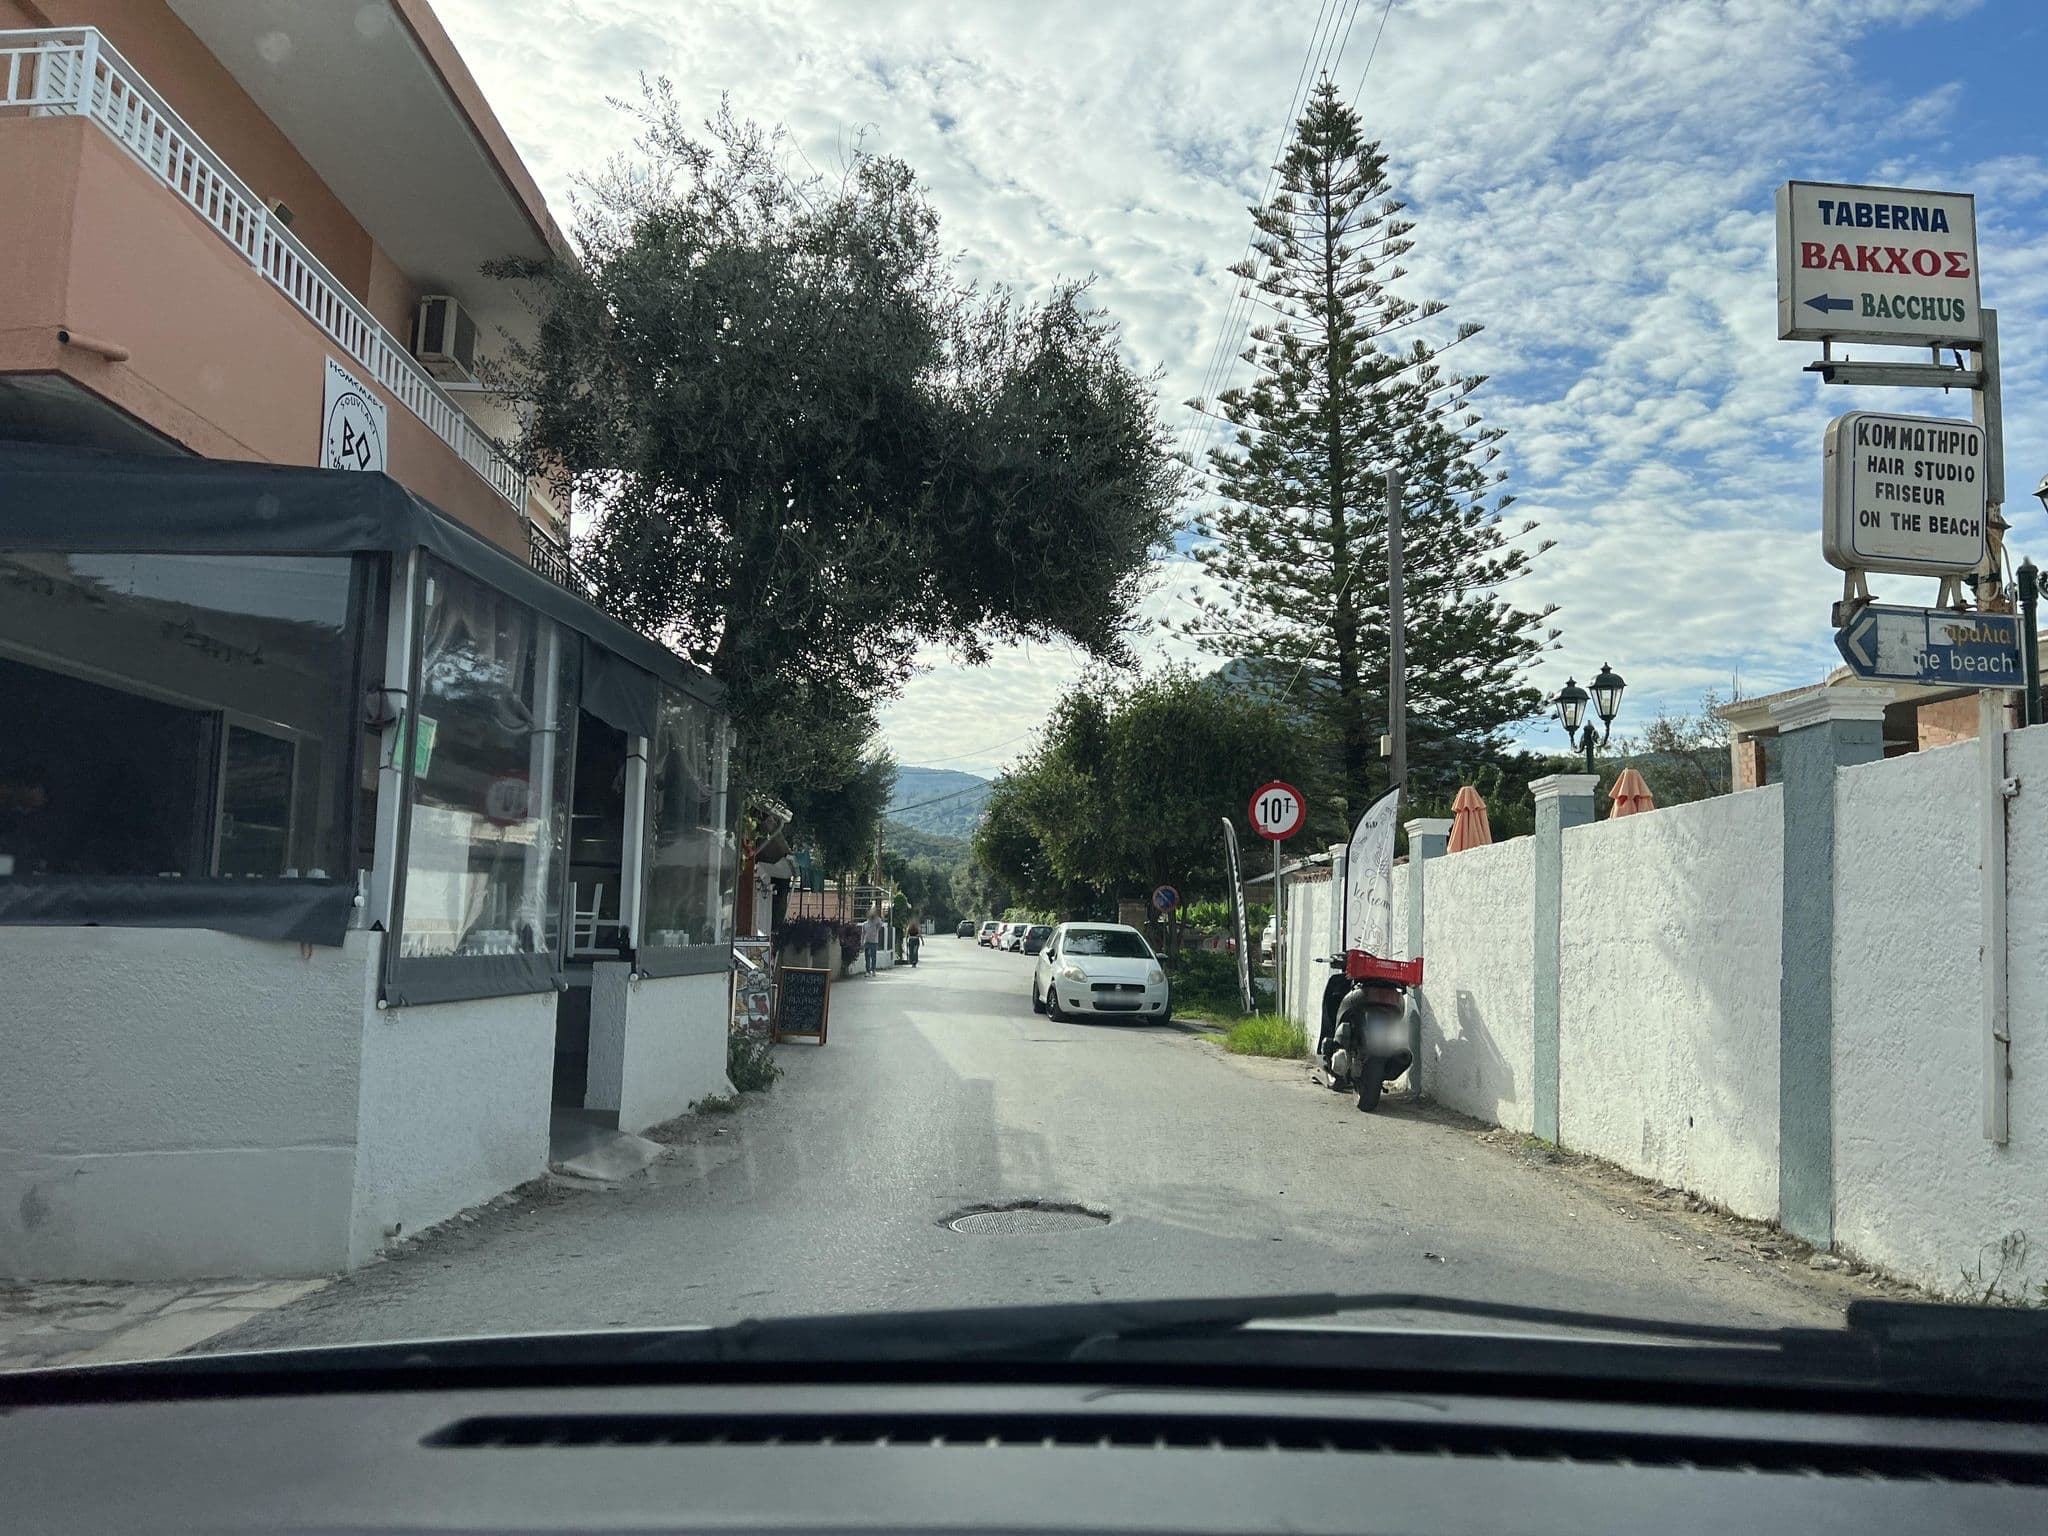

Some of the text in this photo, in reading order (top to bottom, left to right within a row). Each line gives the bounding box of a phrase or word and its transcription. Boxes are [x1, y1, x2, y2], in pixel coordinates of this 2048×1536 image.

[1818, 200, 1950, 233] TABERNA
[1801, 241, 1970, 278] ΒΑΚΧΟΣ
[1861, 293, 1965, 323] BACCHUS
[1867, 455, 1975, 483] HAIR STUDIO
[1875, 482, 1945, 506] FRISEUR
[1859, 510, 1980, 537] ON THE BEACH
[1944, 622, 2011, 646] αραλια
[1950, 649, 2014, 673] beach
